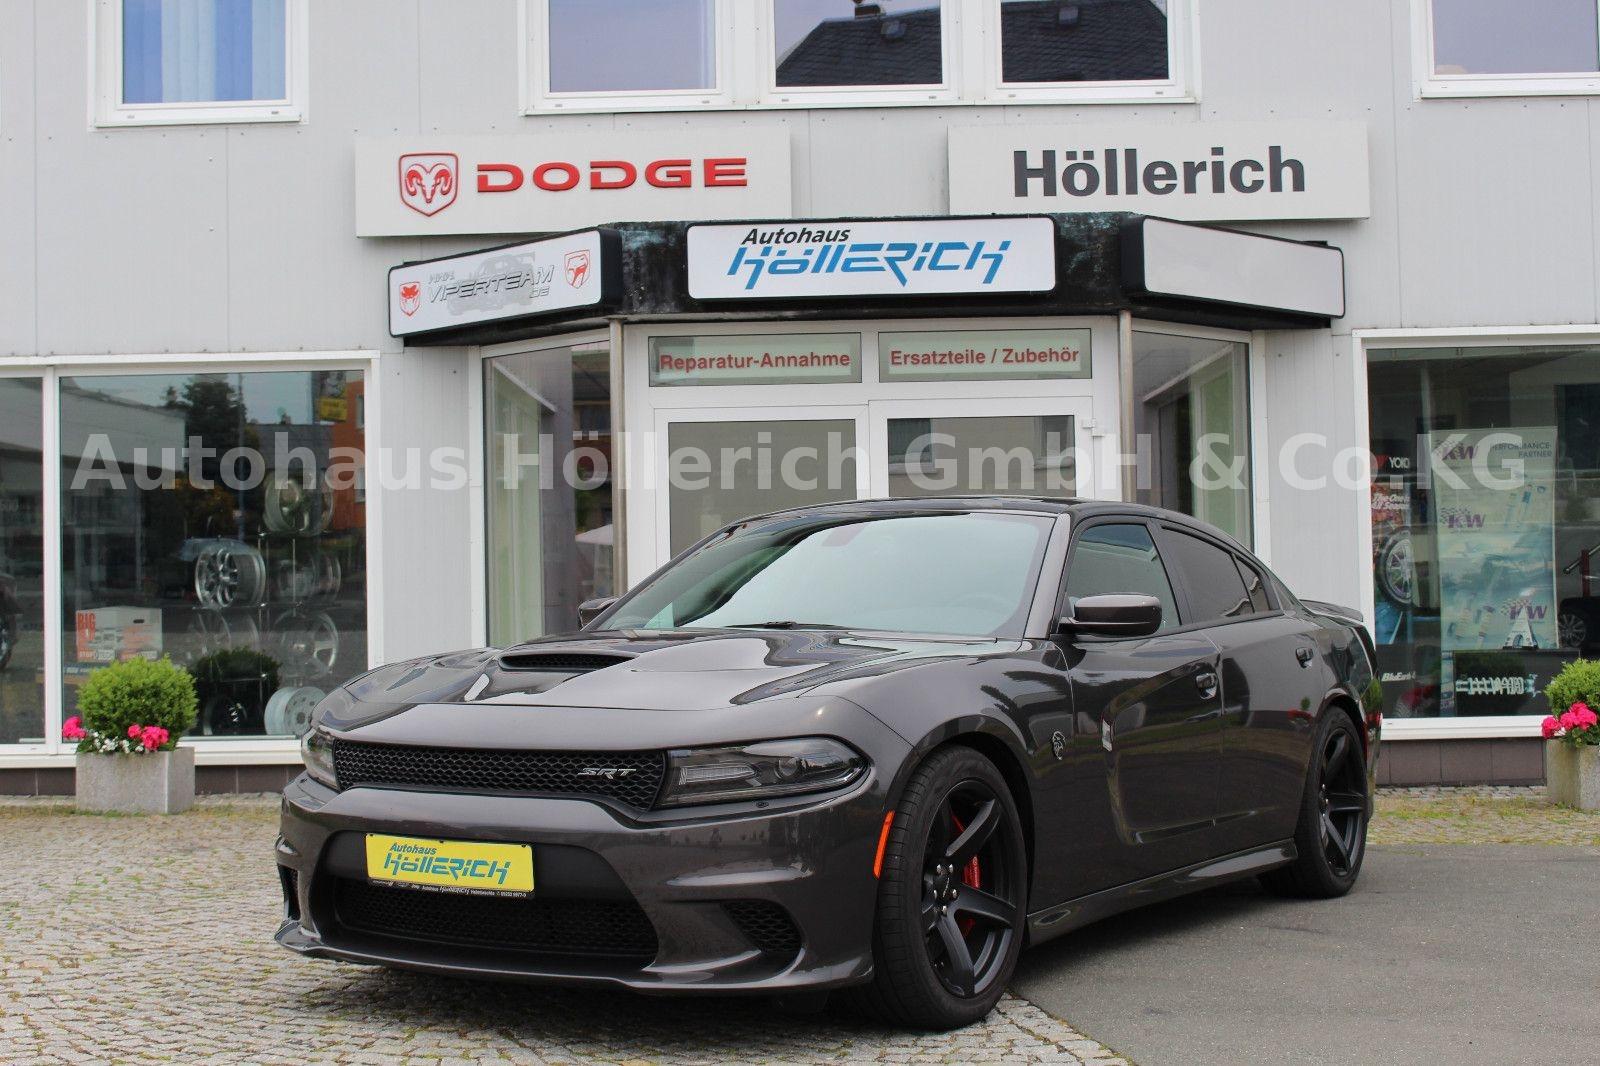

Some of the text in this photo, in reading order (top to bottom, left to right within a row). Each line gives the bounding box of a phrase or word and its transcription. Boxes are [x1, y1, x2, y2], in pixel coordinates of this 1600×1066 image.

[476, 157, 748, 193] DODGE
[1013, 145, 1305, 197] Höllerich
[741, 227, 852, 245] Autohaus
[659, 351, 851, 374] Reparatur-Annahme
[890, 347, 1080, 367] Ersatzteile / Zubehör
[1447, 513, 1487, 528] KW
[576, 767, 637, 780] SRT
[389, 842, 438, 856] Autohaus
